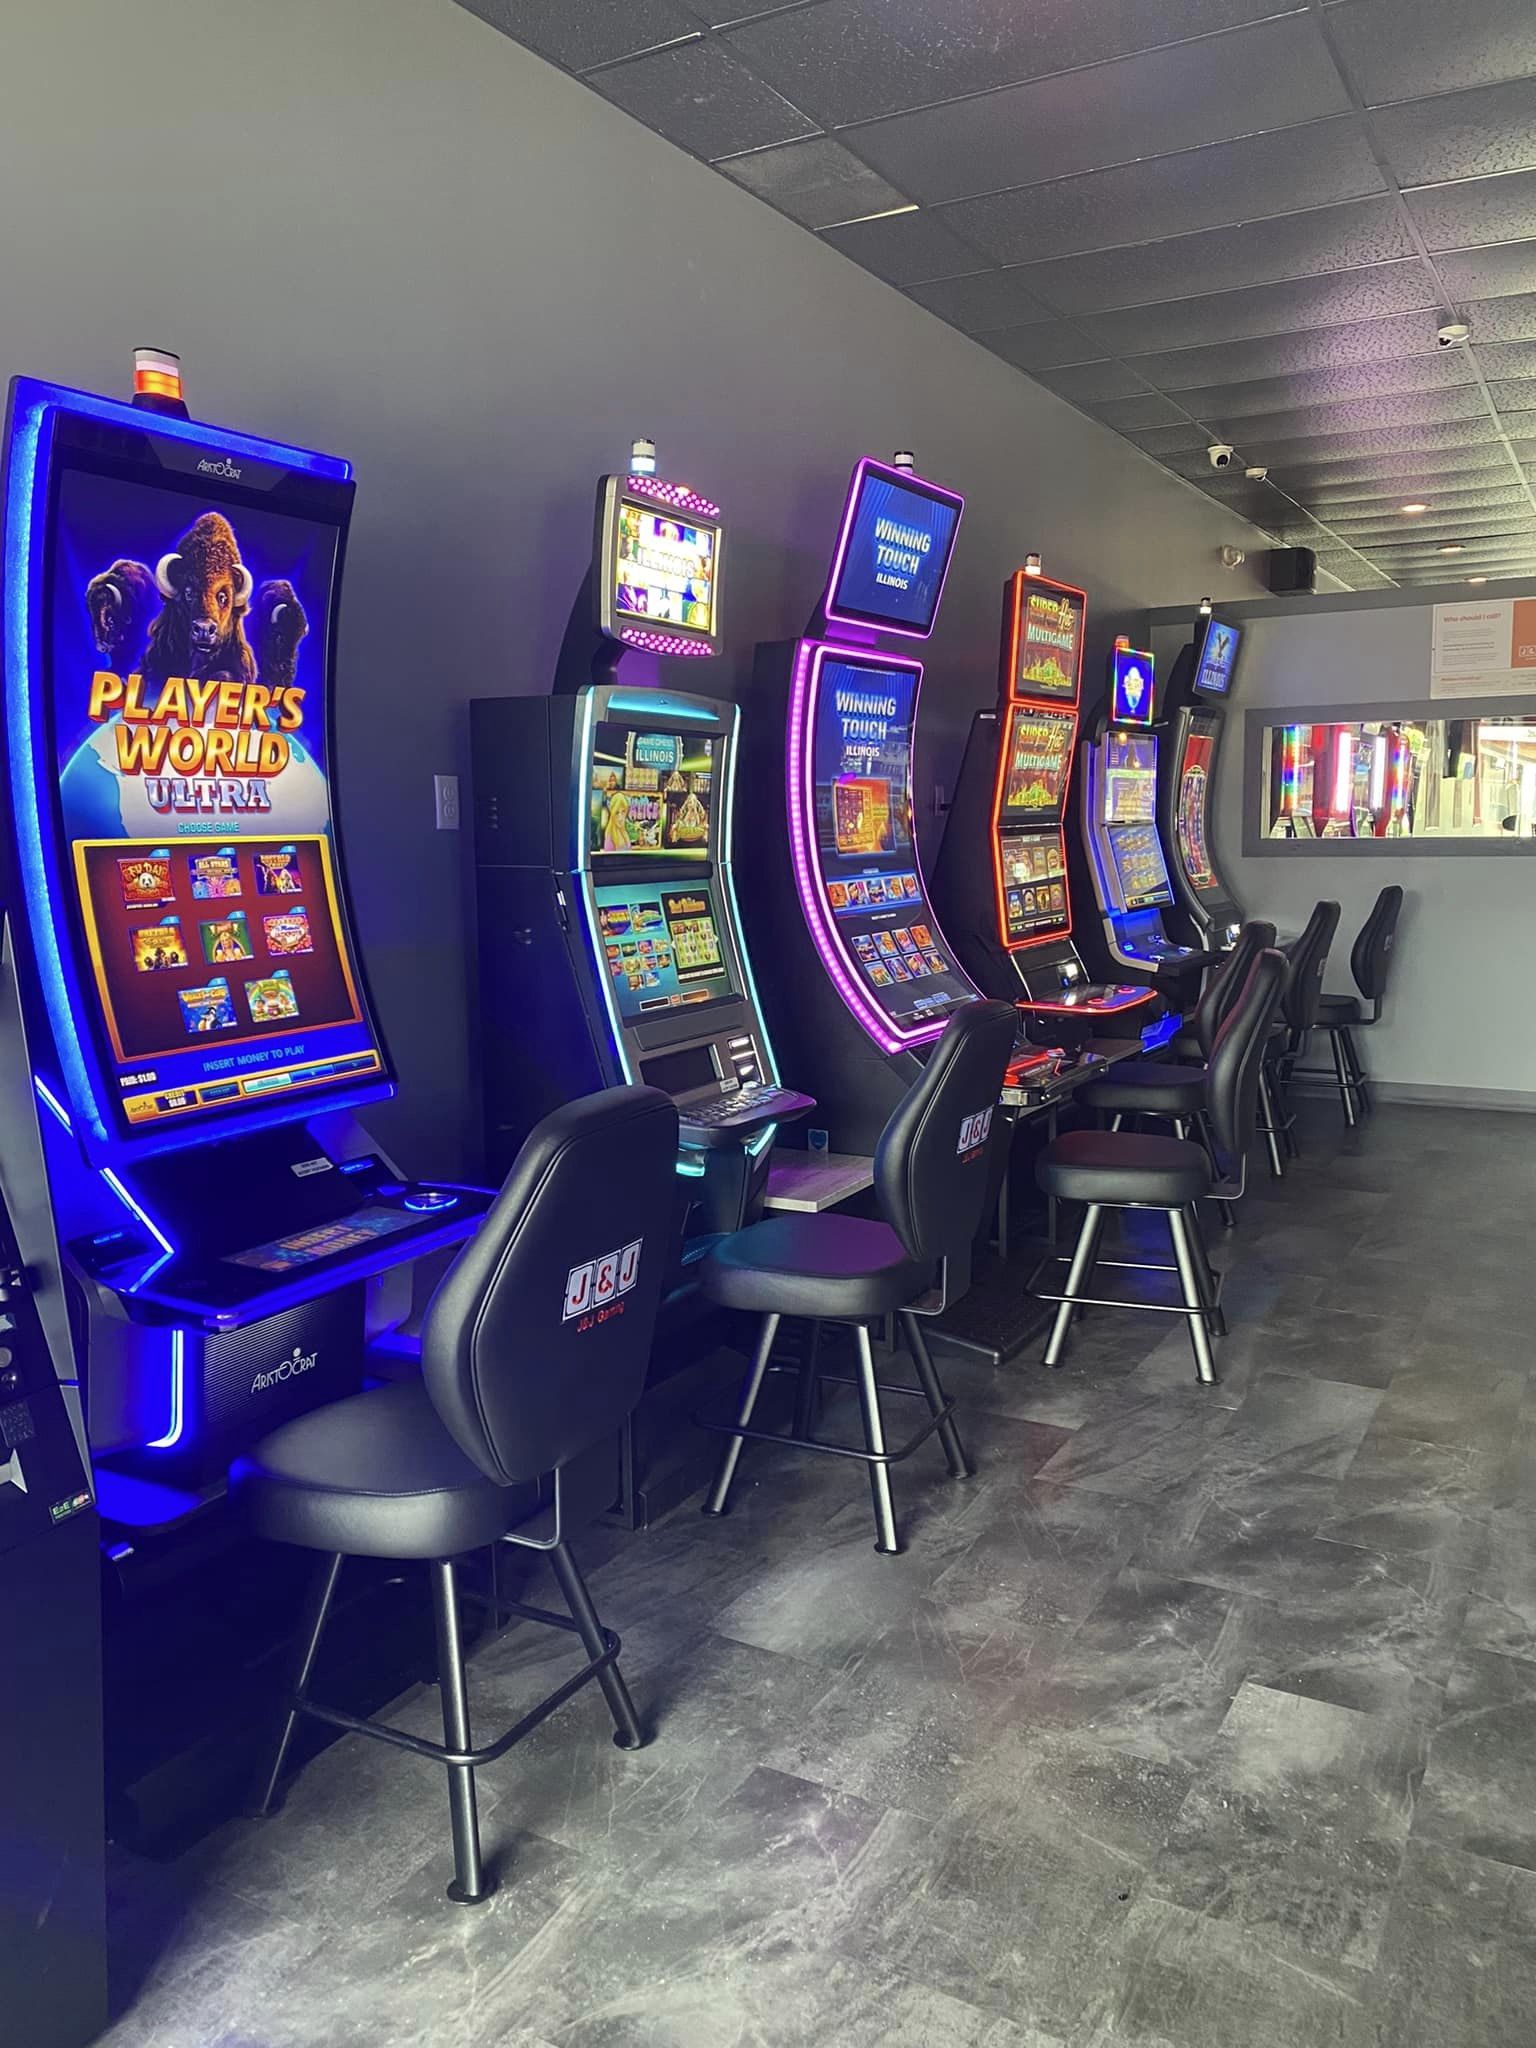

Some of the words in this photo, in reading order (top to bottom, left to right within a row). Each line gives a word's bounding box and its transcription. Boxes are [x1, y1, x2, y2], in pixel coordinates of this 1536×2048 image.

[197, 458, 241, 479] ARISTOCRAT
[875, 517, 931, 553] WINNING
[877, 545, 920, 575] TOUCH
[876, 572, 908, 590] ILLINOIS
[1027, 623, 1073, 651] MULTIGAME
[88, 671, 306, 733] PLAYER'S
[836, 690, 896, 716] WINNING
[841, 718, 887, 740] TOUCH
[114, 724, 290, 778] WORLD
[636, 748, 674, 763] ILLINOIS
[846, 745, 880, 757] ILLINOIS
[144, 778, 272, 813] ULTRA
[178, 822, 213, 833] CHOOSE
[215, 821, 240, 833] GAME
[203, 1057, 235, 1072] INSERT
[236, 1051, 269, 1066] MONEY
[270, 1049, 284, 1059] TO
[284, 1045, 305, 1057] PLAY
[960, 1108, 992, 1148] J&J
[568, 1247, 638, 1309] J&J
[251, 1347, 318, 1393] ARISTOCRAT
